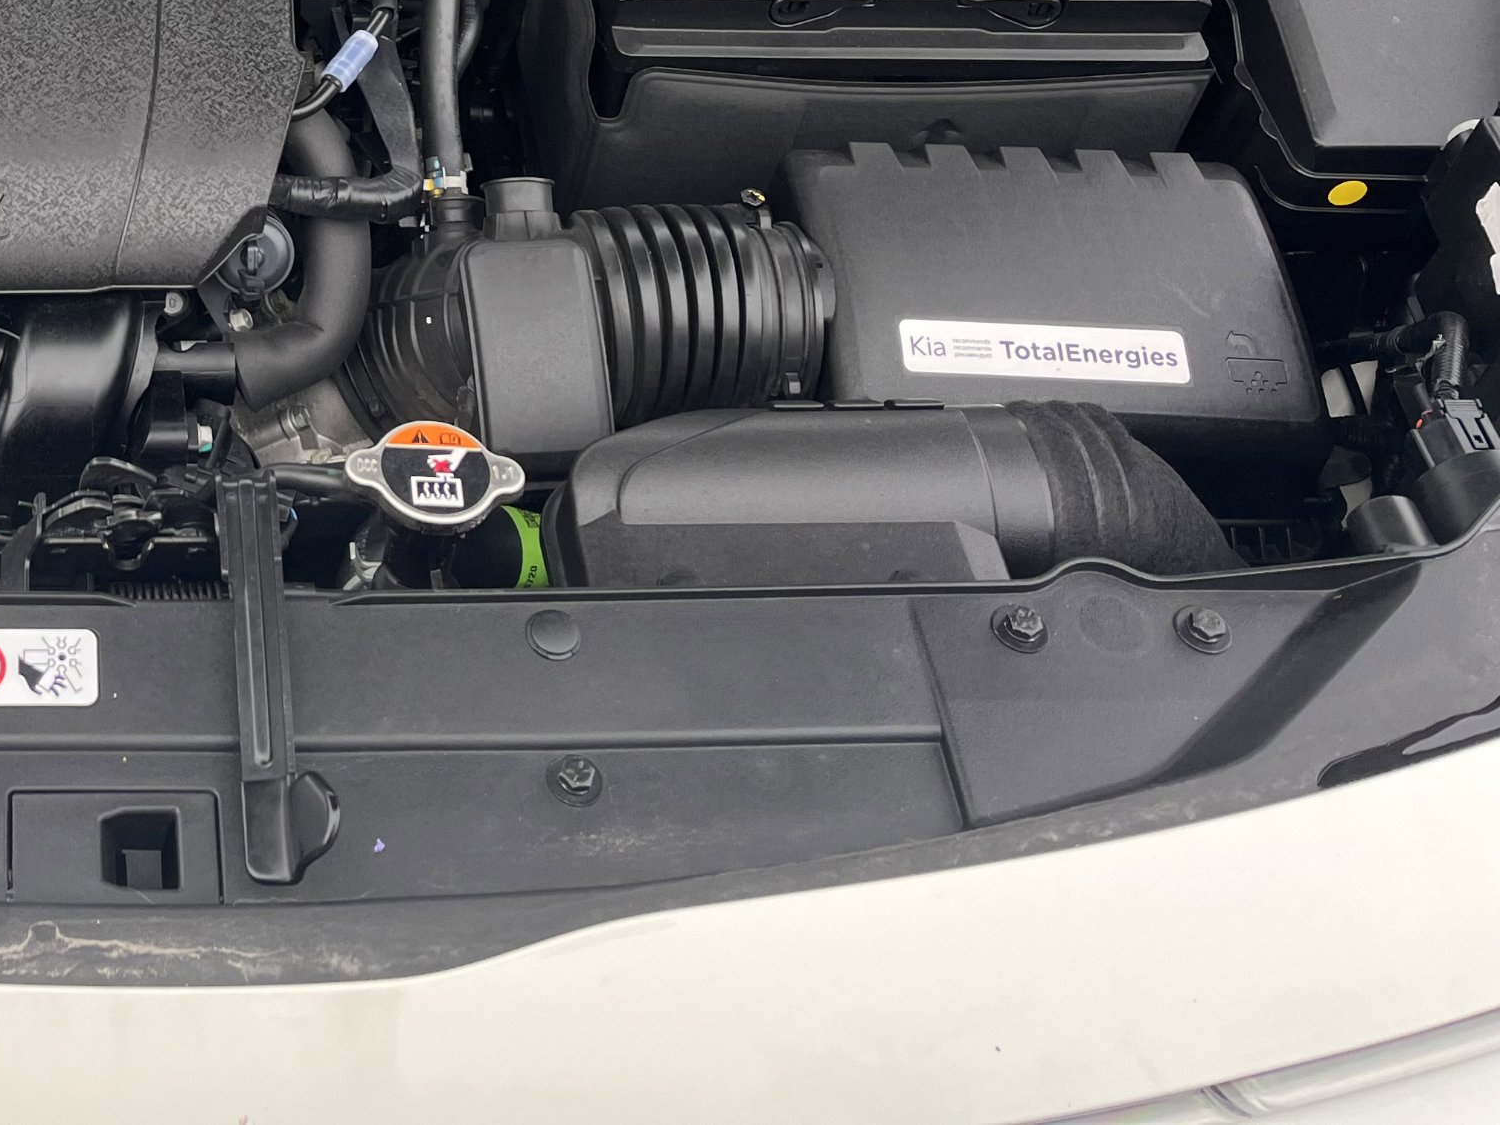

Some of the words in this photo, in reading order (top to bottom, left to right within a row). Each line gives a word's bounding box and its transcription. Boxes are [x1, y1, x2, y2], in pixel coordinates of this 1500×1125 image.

[909, 335, 947, 357] Kia
[998, 340, 1179, 369] TotalEnergies
[356, 457, 379, 472] DCC
[492, 465, 516, 481] 1.1
